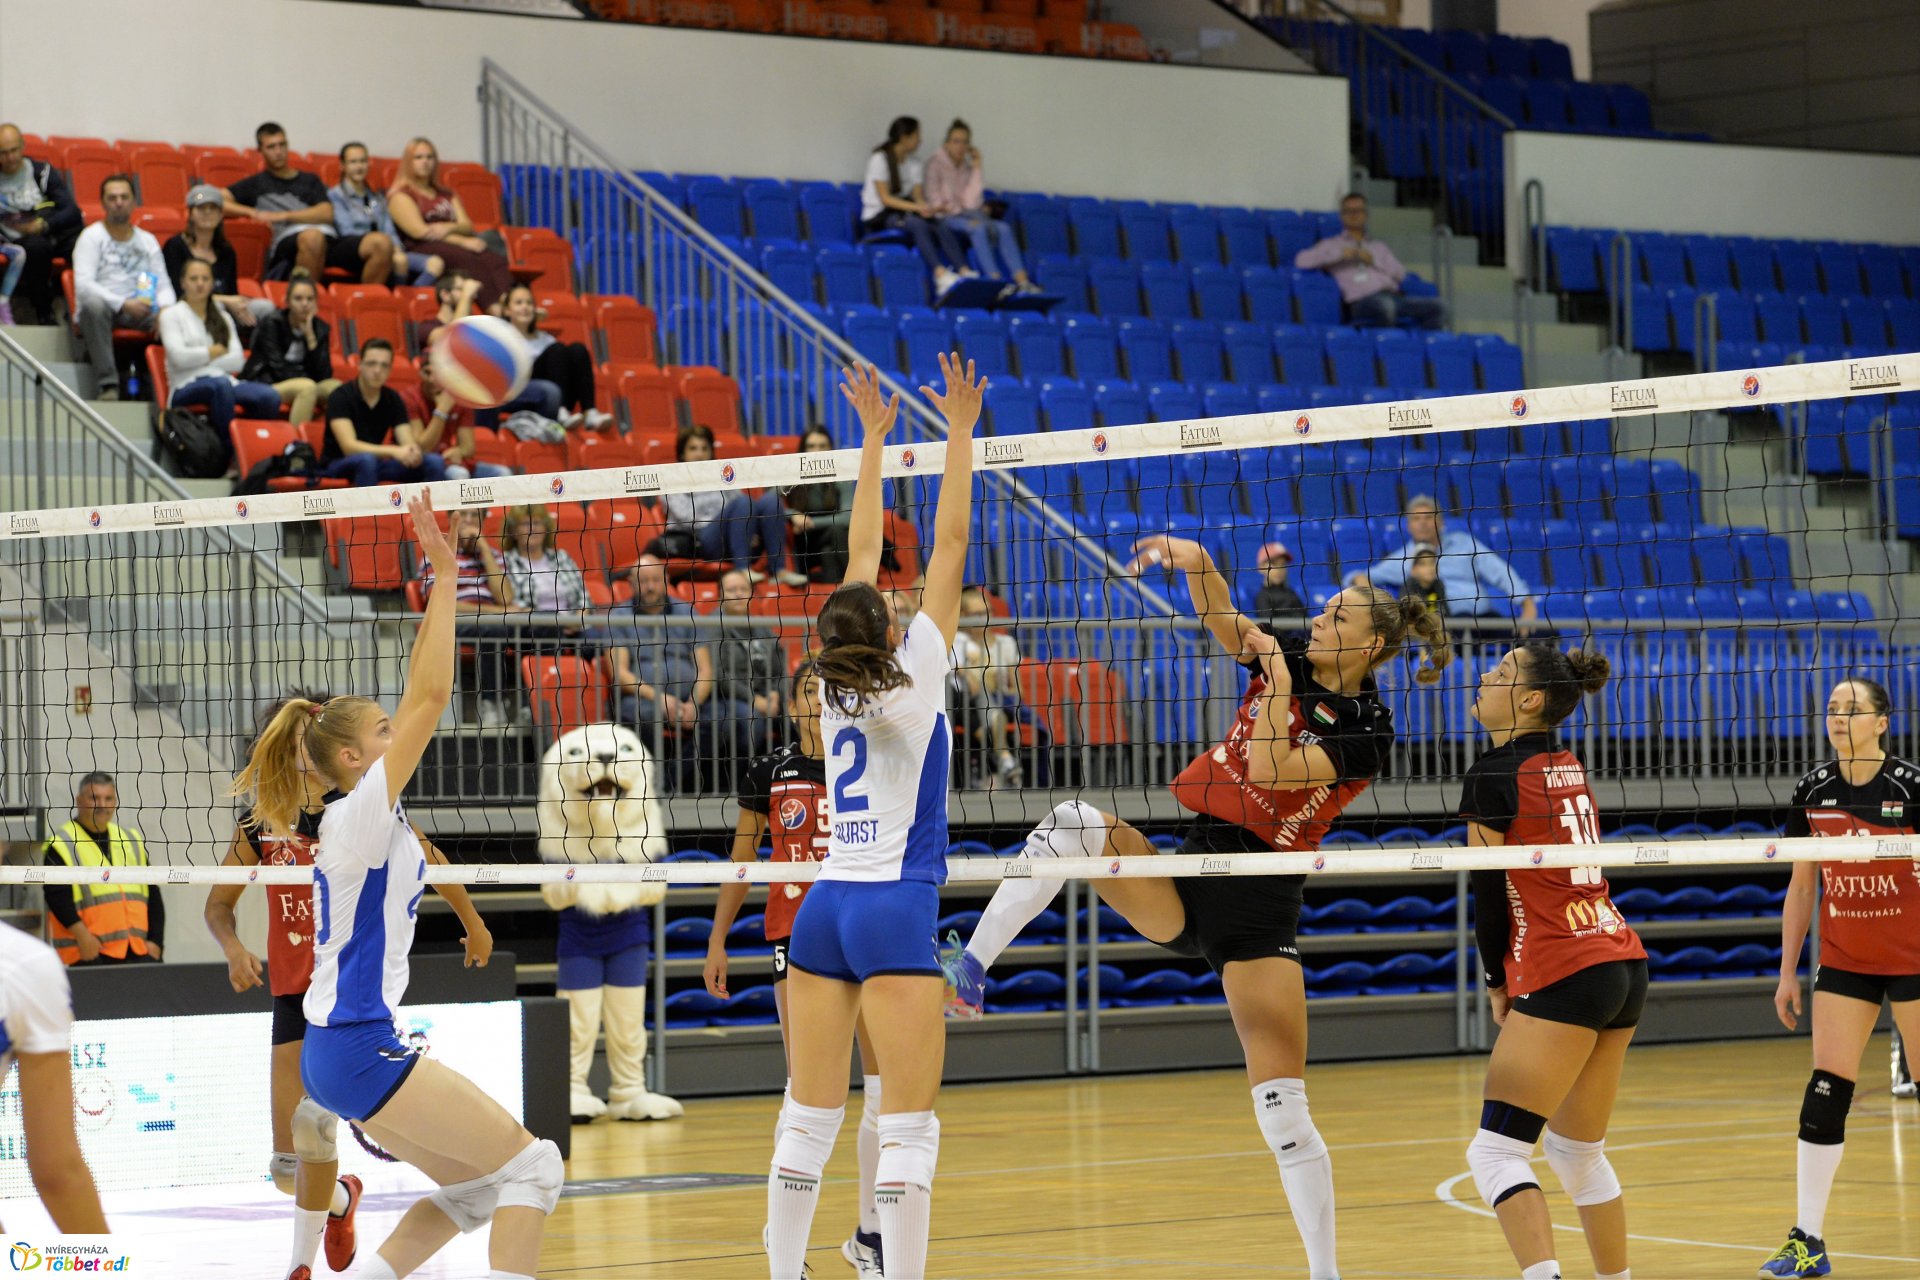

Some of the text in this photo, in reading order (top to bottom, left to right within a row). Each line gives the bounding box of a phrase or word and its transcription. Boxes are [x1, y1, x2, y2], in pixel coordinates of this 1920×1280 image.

[1849, 364, 1899, 381] FATUM
[1610, 386, 1656, 403] FATUM
[1388, 406, 1432, 423] FATUM
[1180, 425, 1220, 441] FATUM
[984, 441, 1023, 457] FATUM
[799, 456, 835, 471] FATUM
[625, 471, 659, 486] FATUM
[460, 483, 493, 497] FATUM
[303, 495, 334, 508] FATUM
[153, 505, 184, 518] FATUM
[10, 515, 39, 528] FATUM
[823, 706, 884, 722] BUDAEST
[780, 769, 799, 778] JAKO
[832, 727, 870, 814] 2
[1821, 798, 1838, 806] JAKO
[1274, 785, 1332, 847] NYÍREGYH
[1635, 846, 1669, 858] FATUM
[1876, 839, 1912, 852] FATUM
[1201, 857, 1231, 869] FATUM
[1411, 852, 1443, 864] FATUM
[24, 868, 46, 879] FATUM
[168, 869, 190, 879] FATUM
[476, 868, 501, 878] FATUM
[642, 866, 668, 877] FATUM
[1004, 862, 1032, 873] FATUM
[1823, 867, 1898, 893] FATUM
[775, 945, 785, 972] 5
[784, 1181, 813, 1192] HUN
[876, 1196, 899, 1204] HUN
